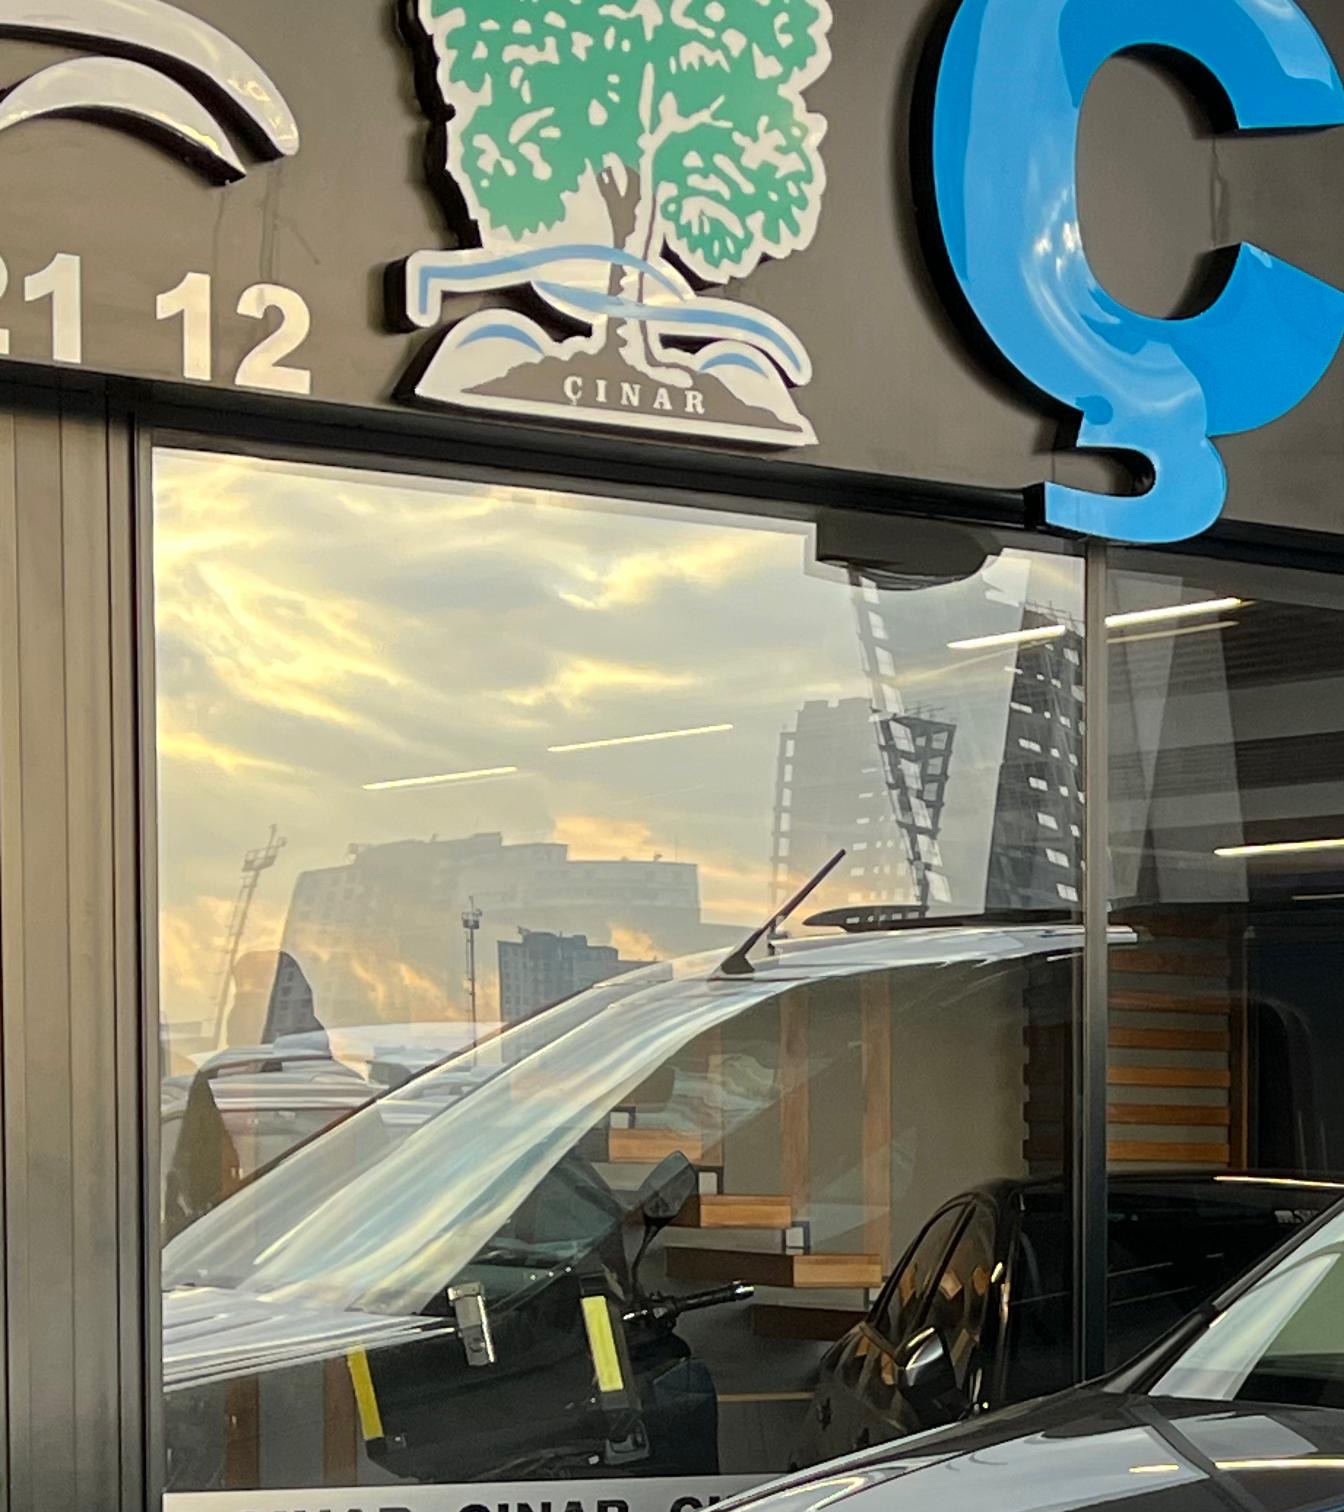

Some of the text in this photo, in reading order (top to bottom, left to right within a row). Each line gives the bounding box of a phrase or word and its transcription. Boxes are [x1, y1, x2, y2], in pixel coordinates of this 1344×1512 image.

[0, 252, 311, 394] 1 12
[563, 376, 705, 414] ÇINAR
